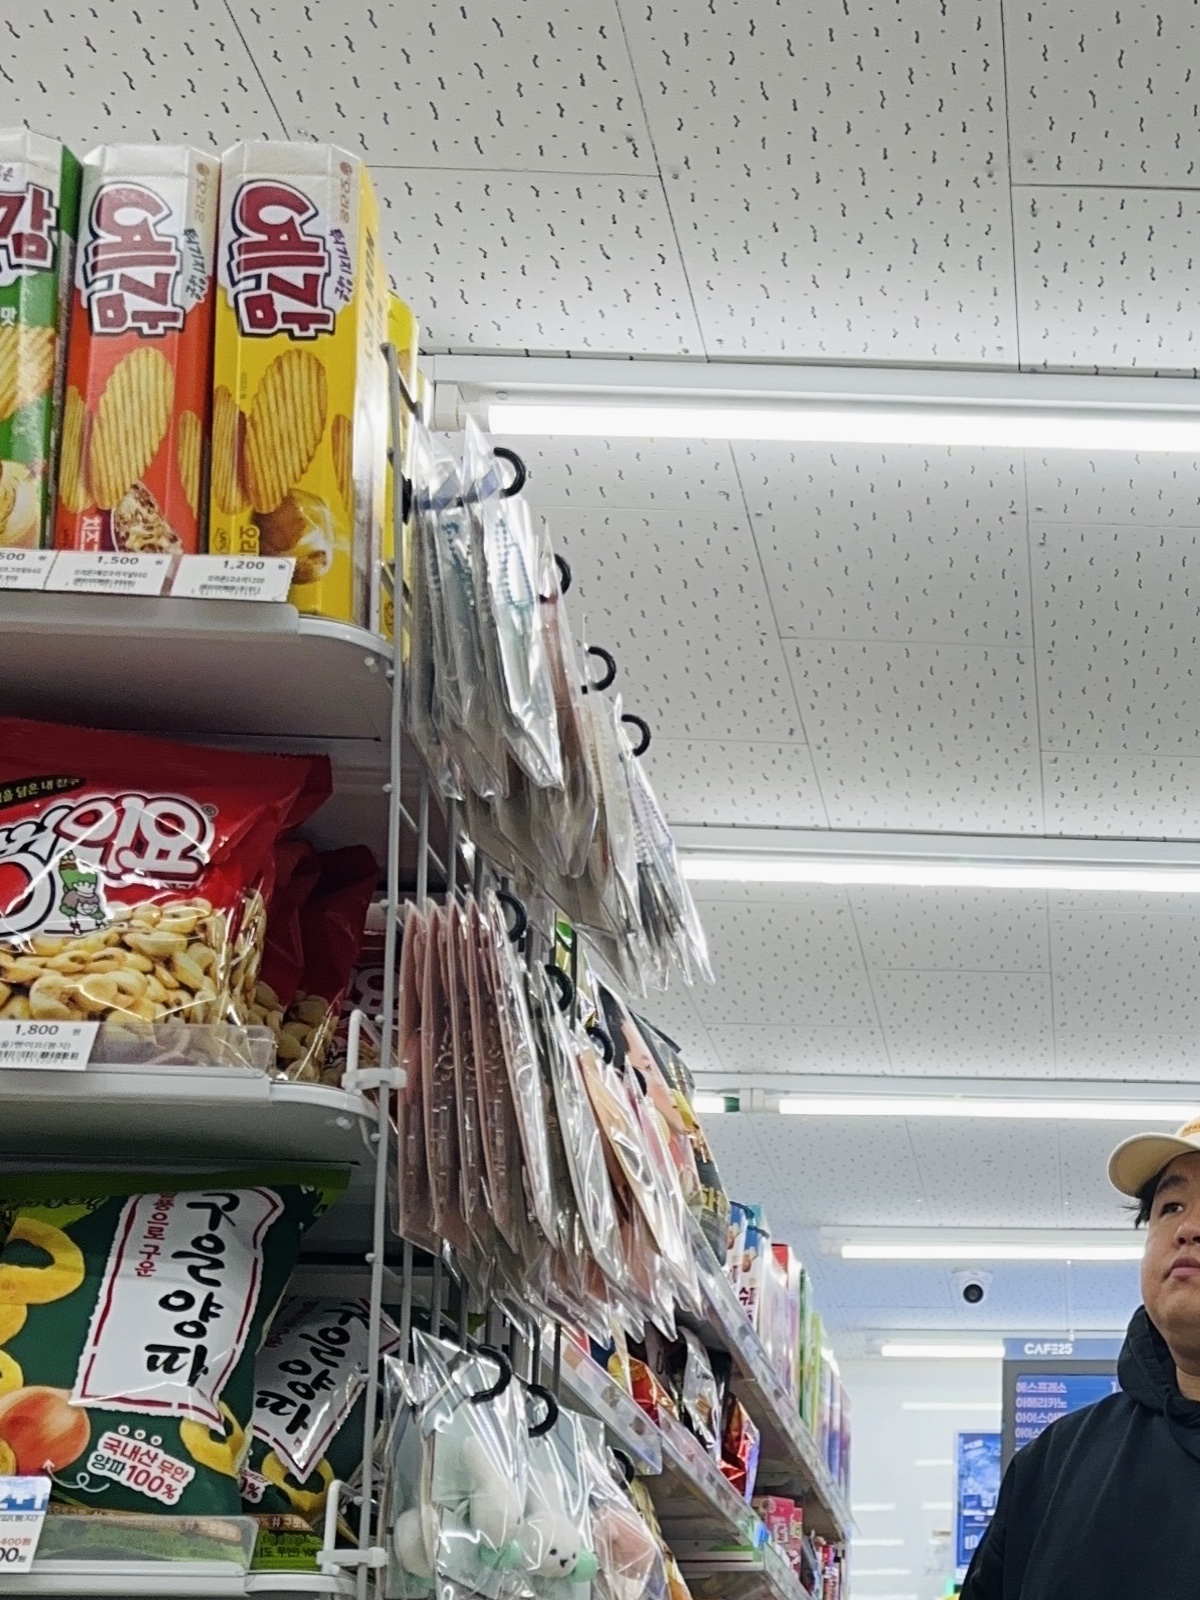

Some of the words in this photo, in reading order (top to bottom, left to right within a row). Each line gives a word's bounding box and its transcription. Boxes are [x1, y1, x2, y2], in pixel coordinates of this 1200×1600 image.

[90, 183, 186, 334] 예감
[235, 182, 333, 335] 예감
[96, 555, 139, 566] 1,500
[222, 560, 265, 570] 1,200
[14, 1024, 59, 1036] 1,800
[1023, 1343, 1074, 1355] CAFE25
[1015, 1397, 1067, 1409] 아메리카노
[102, 1436, 158, 1467] 국내산
[156, 1456, 191, 1483] 무안
[90, 1453, 128, 1478] 양파
[126, 1466, 178, 1501] 100%
